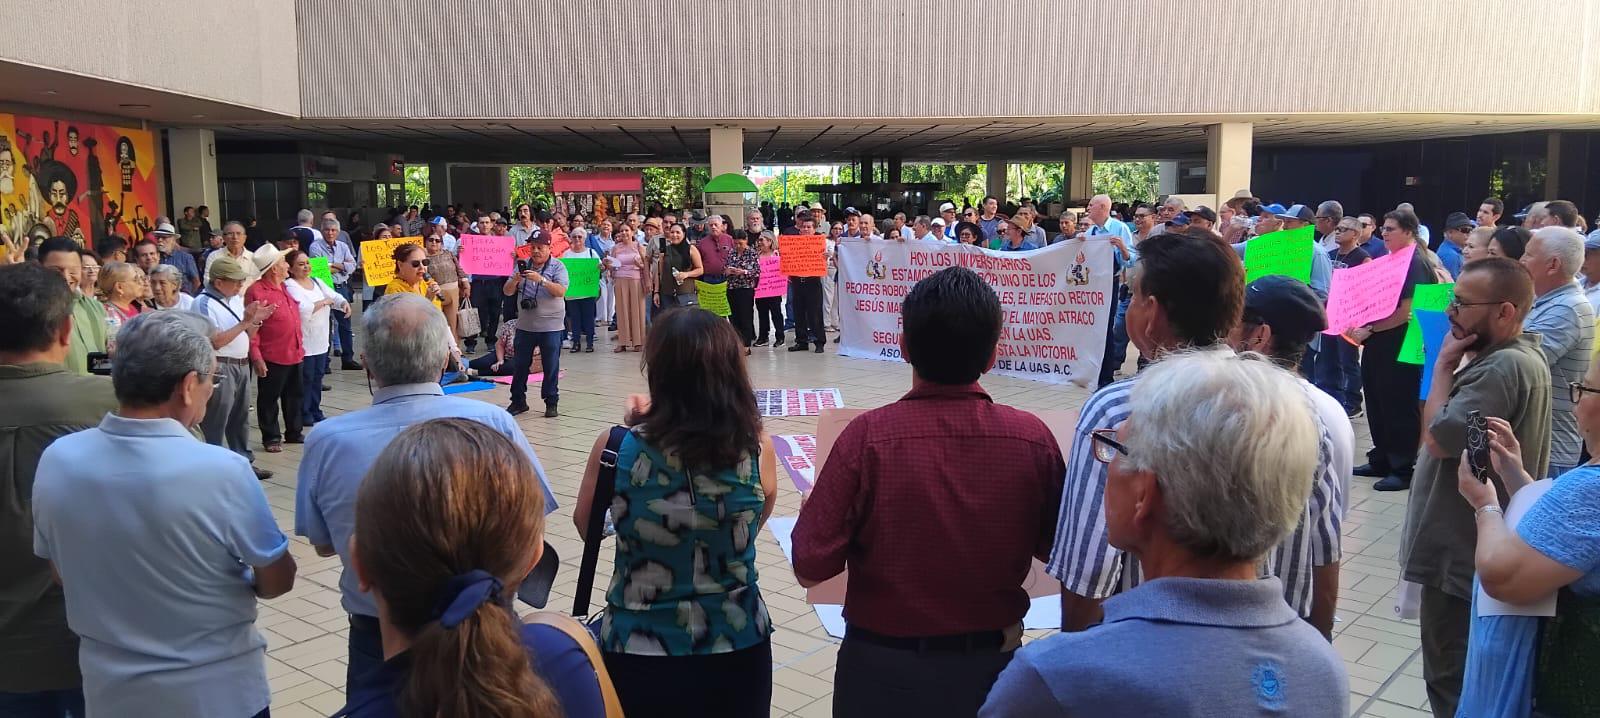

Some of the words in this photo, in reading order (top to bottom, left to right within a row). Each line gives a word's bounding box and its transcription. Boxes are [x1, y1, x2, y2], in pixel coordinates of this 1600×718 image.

[911, 252, 928, 266] HOY
[931, 253, 951, 267] LOS
[999, 274, 1020, 287] UNO
[1022, 274, 1035, 287] DE
[1038, 273, 1056, 287] LOS
[846, 282, 880, 295] PEORES
[883, 285, 908, 297] ROBOS
[855, 297, 884, 312] JESÚS
[1018, 292, 1027, 304] EL
[1030, 292, 1066, 305] NEFASTO
[1069, 291, 1104, 305] RECTOR
[1009, 311, 1020, 323] EL
[1023, 311, 1055, 325] MAYOR
[1058, 311, 1095, 326] ATRACO
[1013, 328, 1025, 341] LA
[1028, 328, 1054, 341] UAS.
[1017, 345, 1030, 357] LA
[999, 360, 1012, 369] DE
[1015, 361, 1026, 372] LA
[1030, 362, 1050, 373] UAS
